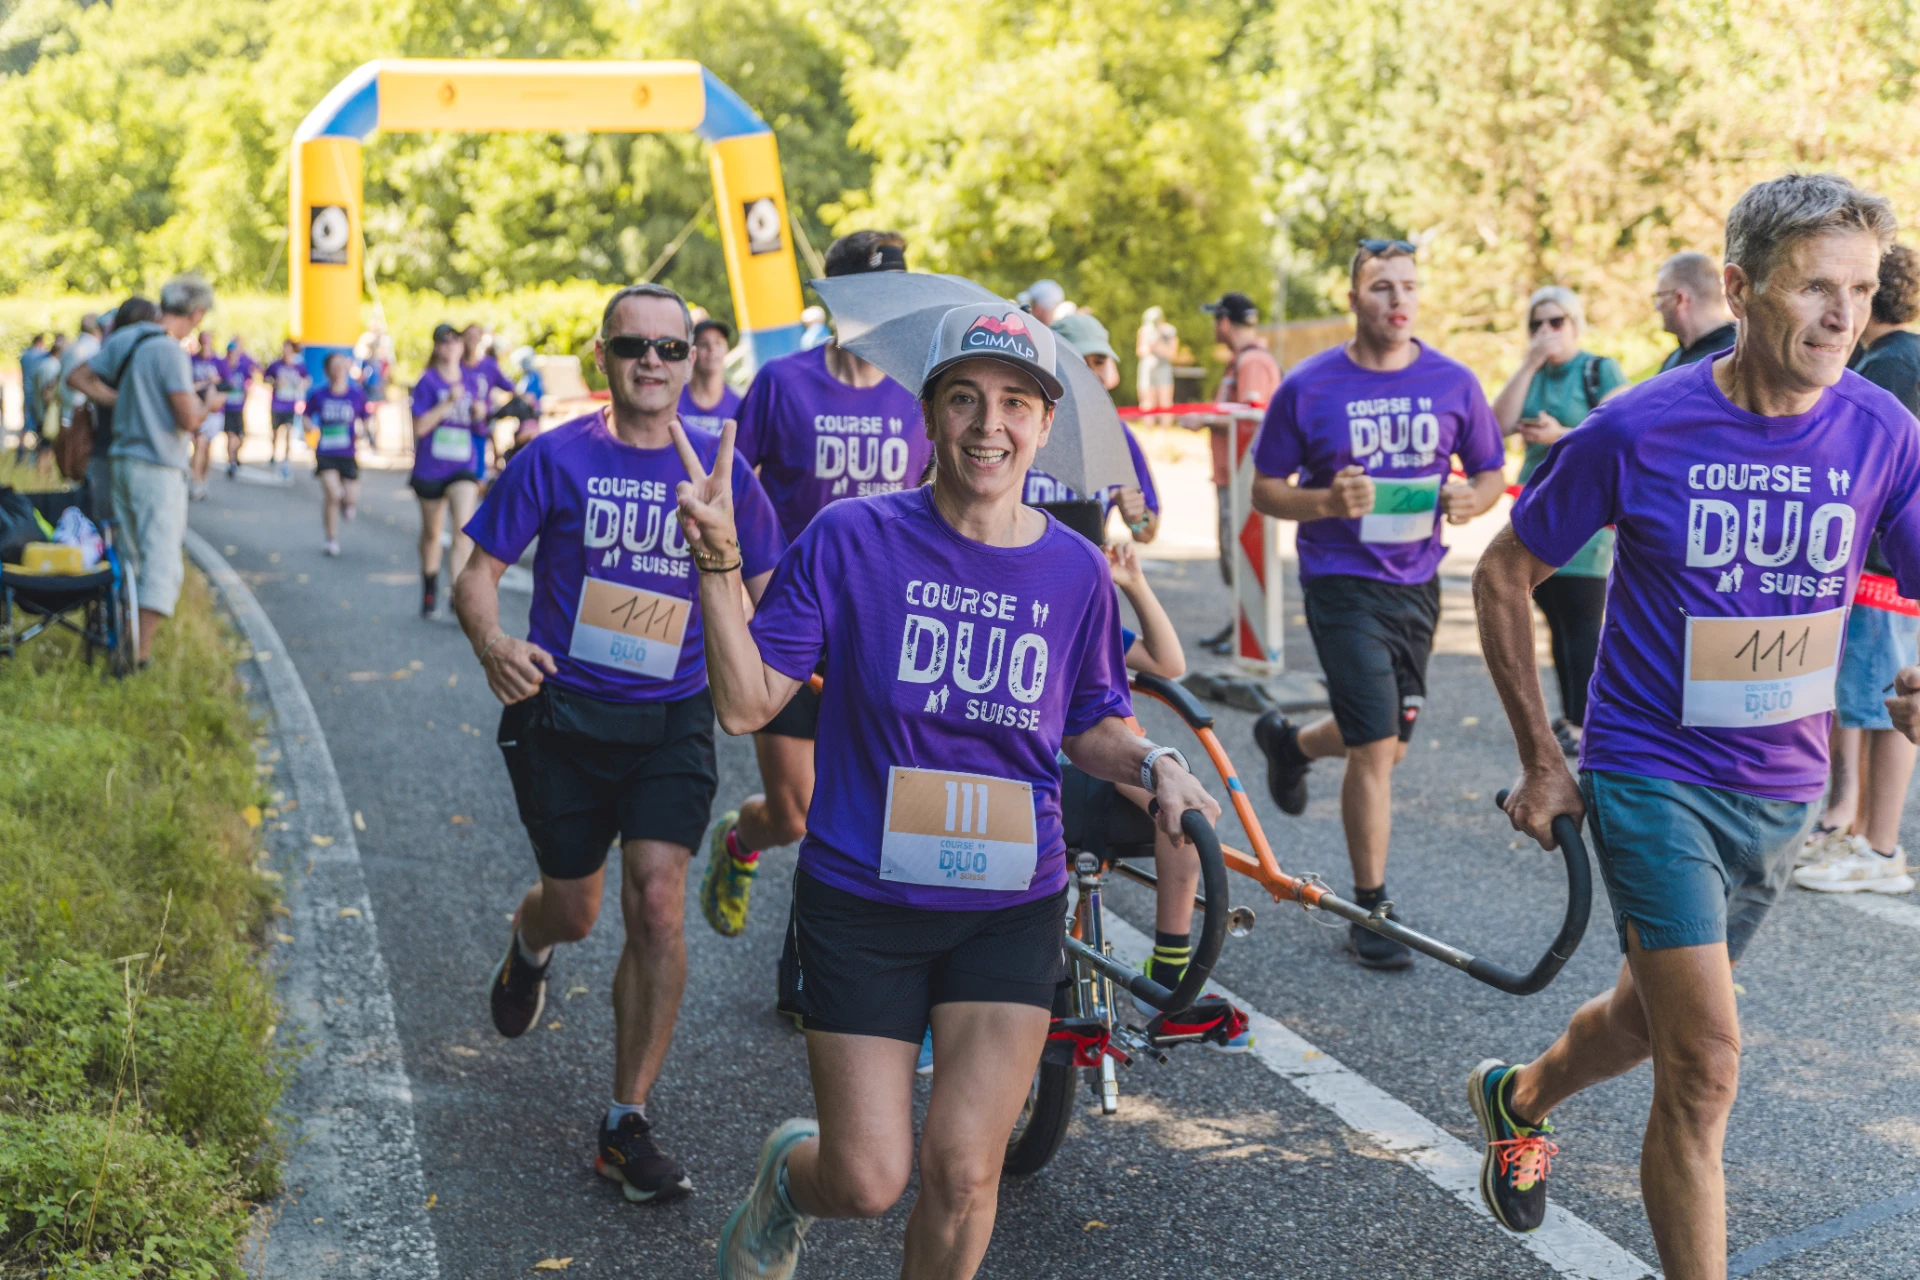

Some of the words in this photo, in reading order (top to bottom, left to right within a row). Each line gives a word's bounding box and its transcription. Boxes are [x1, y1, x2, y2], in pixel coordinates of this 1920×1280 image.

[970, 331, 1035, 358] CIMALP
[1346, 397, 1412, 417] COURSE
[814, 414, 883, 435] COURSE
[1349, 412, 1440, 458] DUO
[815, 435, 909, 482] DUO
[1390, 451, 1436, 469] SUISSE
[587, 476, 667, 502] COURSE
[1688, 463, 1812, 493] COURSE
[584, 497, 692, 559] DUO
[1685, 498, 1857, 574] DUO
[631, 554, 691, 578] SUISSE
[1758, 572, 1846, 598] SUISSE
[906, 579, 1018, 621] COURSE
[611, 594, 676, 639] 111
[609, 641, 647, 662] DUO
[897, 613, 1049, 704] DUO
[1734, 625, 1810, 673] 111
[965, 698, 1041, 732] SUISSE
[1745, 690, 1793, 713] DUO
[944, 780, 989, 835] 111
[940, 839, 975, 850] COURSE
[939, 849, 988, 873] DUO
[960, 872, 987, 881] SUISSE
